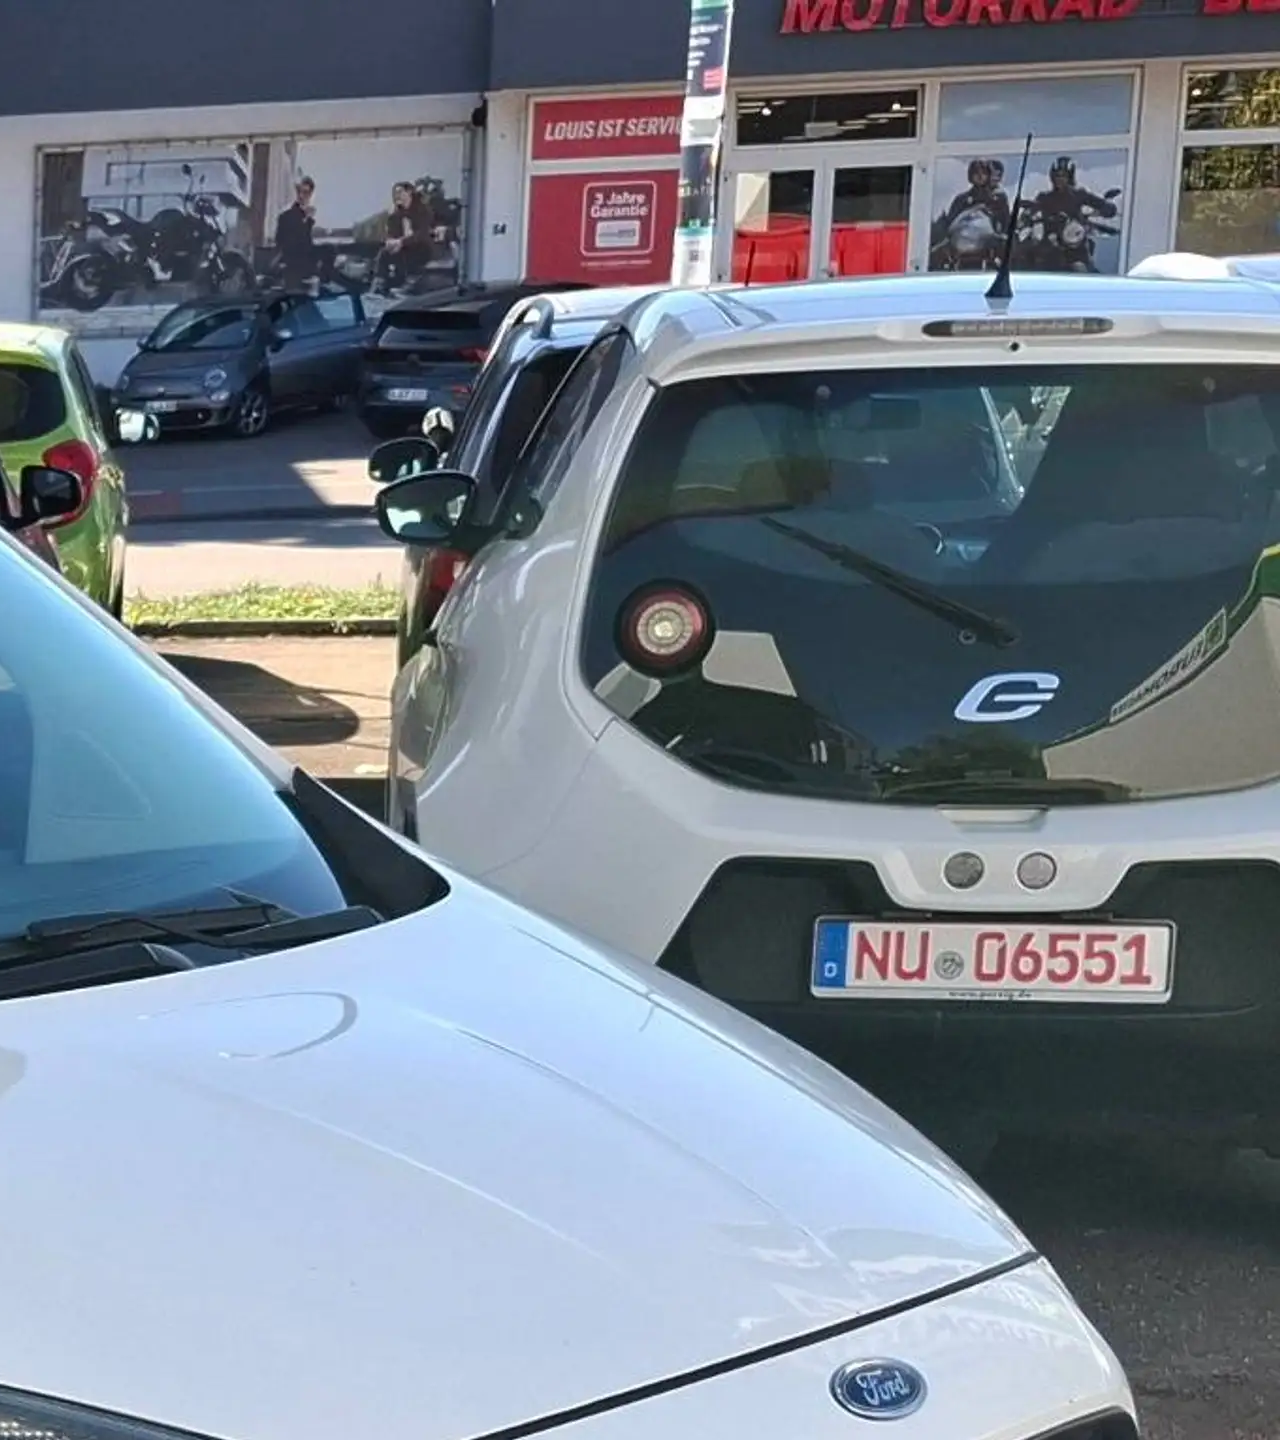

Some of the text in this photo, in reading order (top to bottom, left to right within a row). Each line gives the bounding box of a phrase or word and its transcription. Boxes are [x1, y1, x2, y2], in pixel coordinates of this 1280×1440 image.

[544, 120, 596, 140] LOUIS
[597, 118, 625, 138] IST
[593, 191, 646, 205] 3 Jahre
[591, 205, 649, 218] Garantie
[824, 930, 1153, 986] D NU 06551
[855, 1369, 910, 1406] Ford
